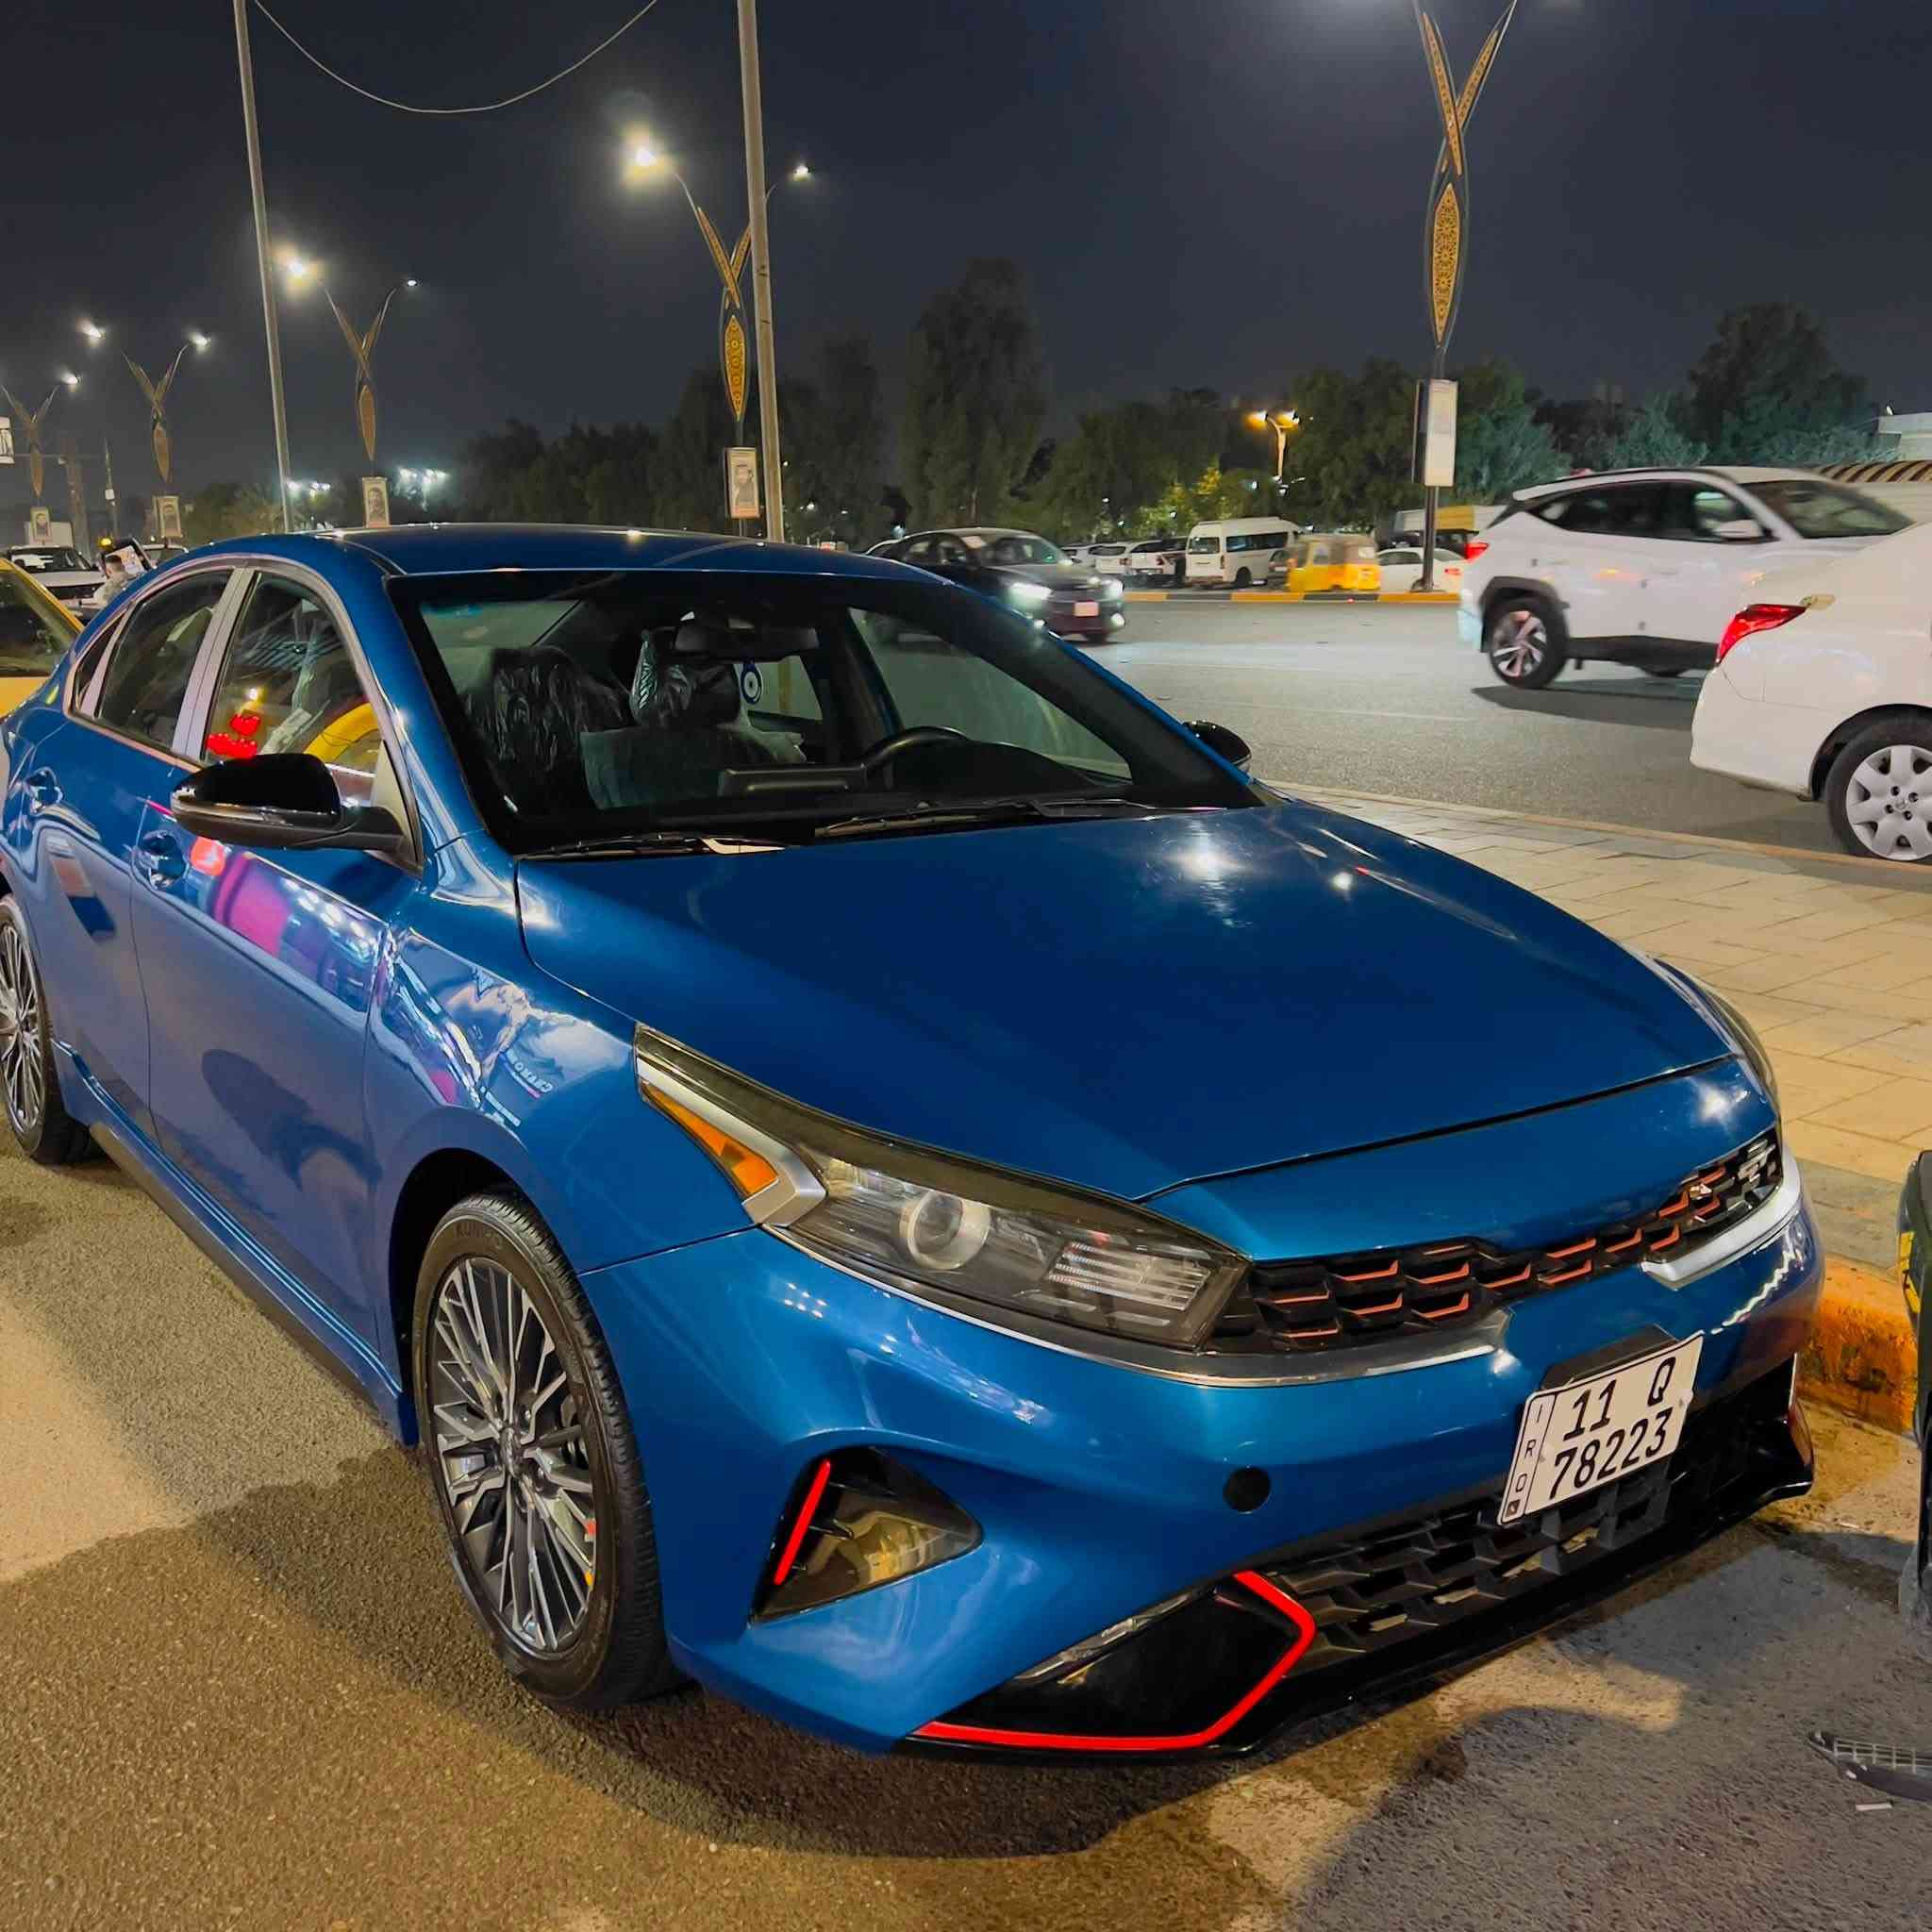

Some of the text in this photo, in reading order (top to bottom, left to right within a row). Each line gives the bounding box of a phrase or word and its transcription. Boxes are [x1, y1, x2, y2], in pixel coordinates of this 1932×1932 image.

[1563, 1357, 1676, 1441] 11 Q
[1550, 1407, 1673, 1500] 78223
